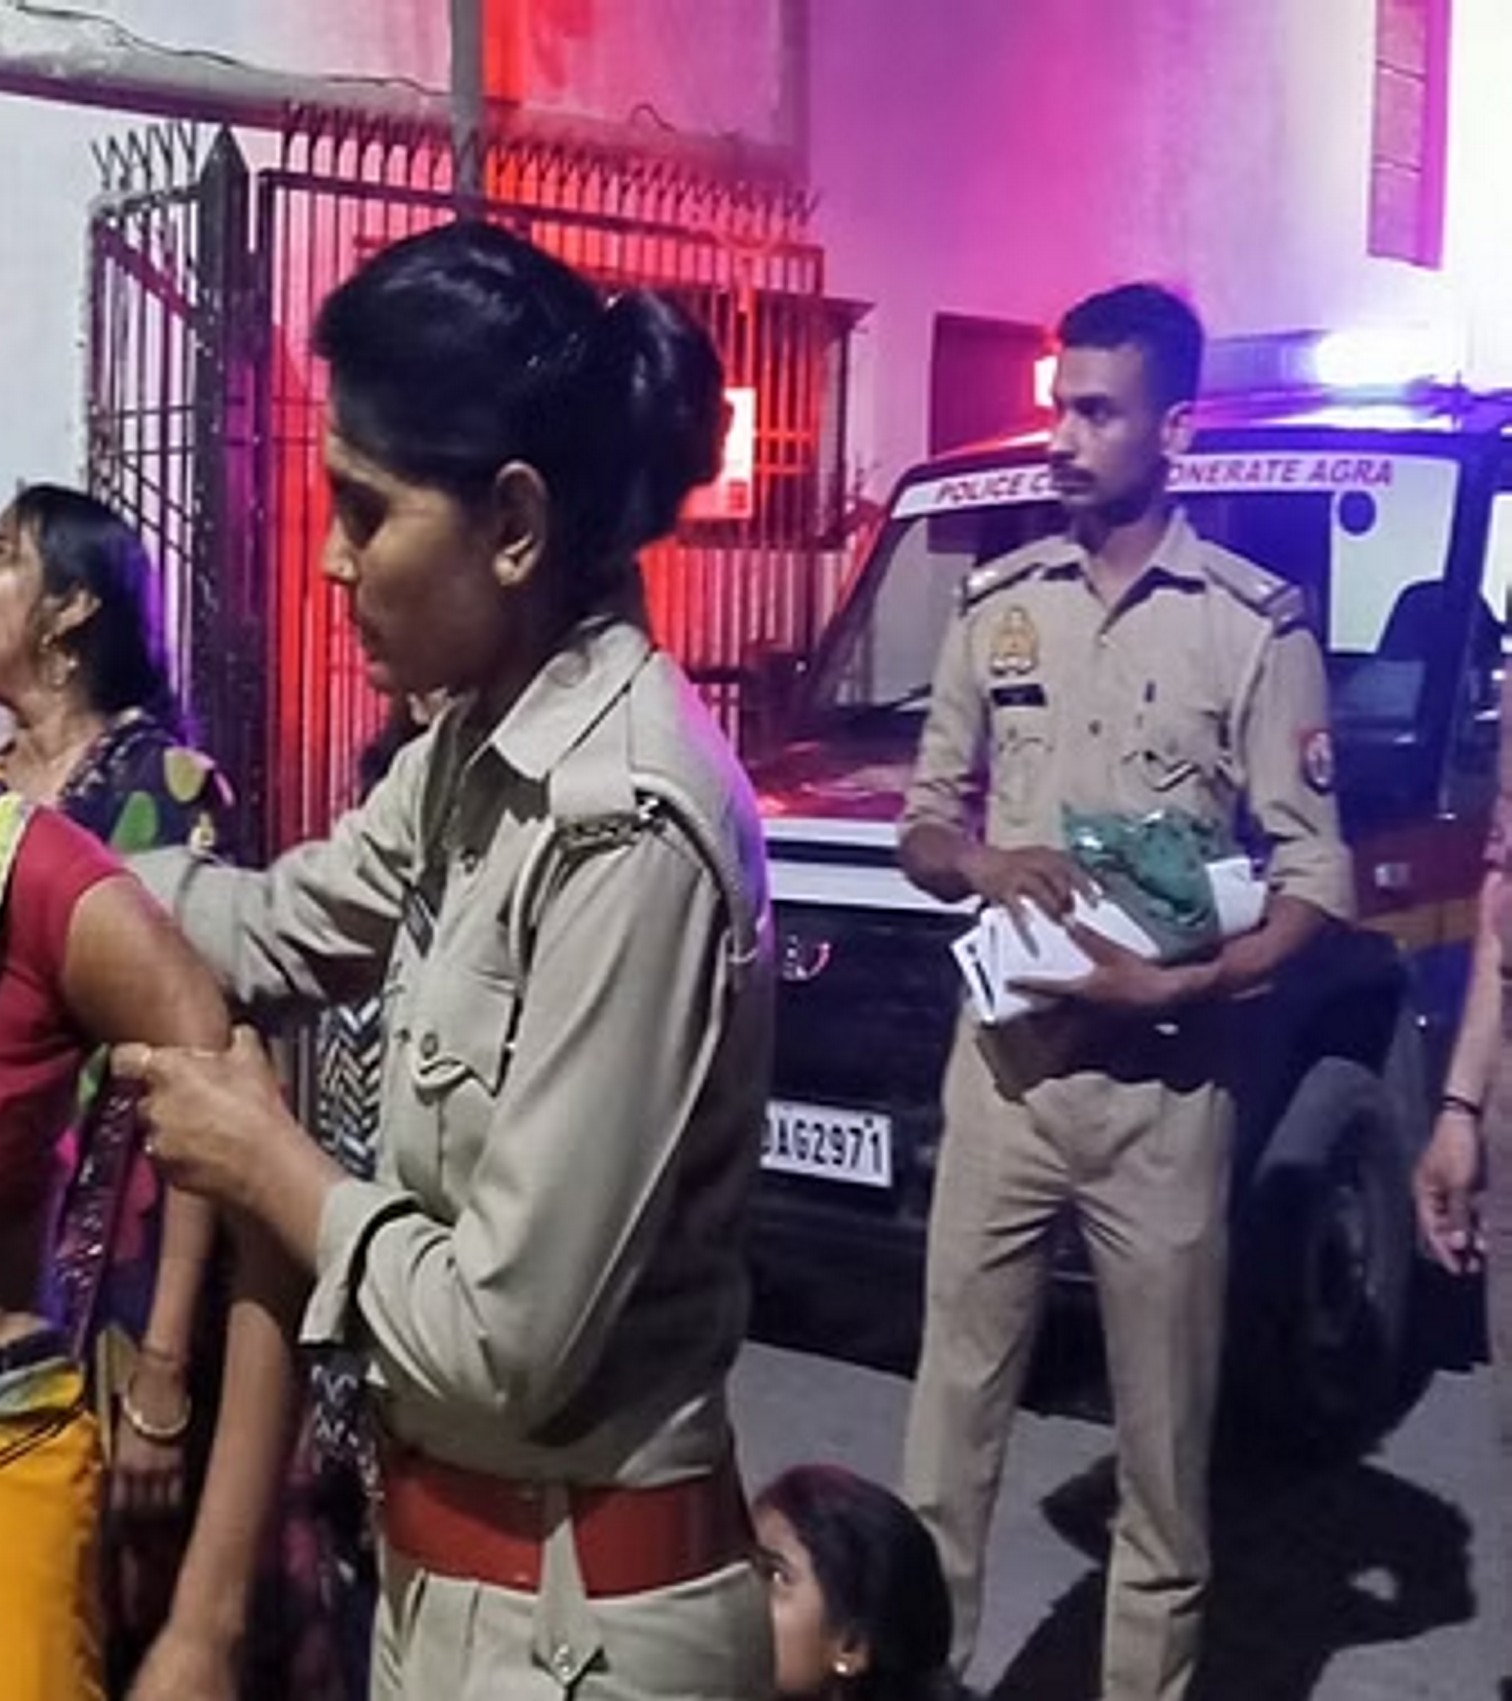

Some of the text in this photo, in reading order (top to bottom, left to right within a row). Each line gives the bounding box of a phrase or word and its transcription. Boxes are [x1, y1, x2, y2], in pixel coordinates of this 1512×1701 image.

[935, 472, 1026, 504] POLICE
[1168, 458, 1301, 486] ONERATE
[1307, 458, 1394, 487] AGRA
